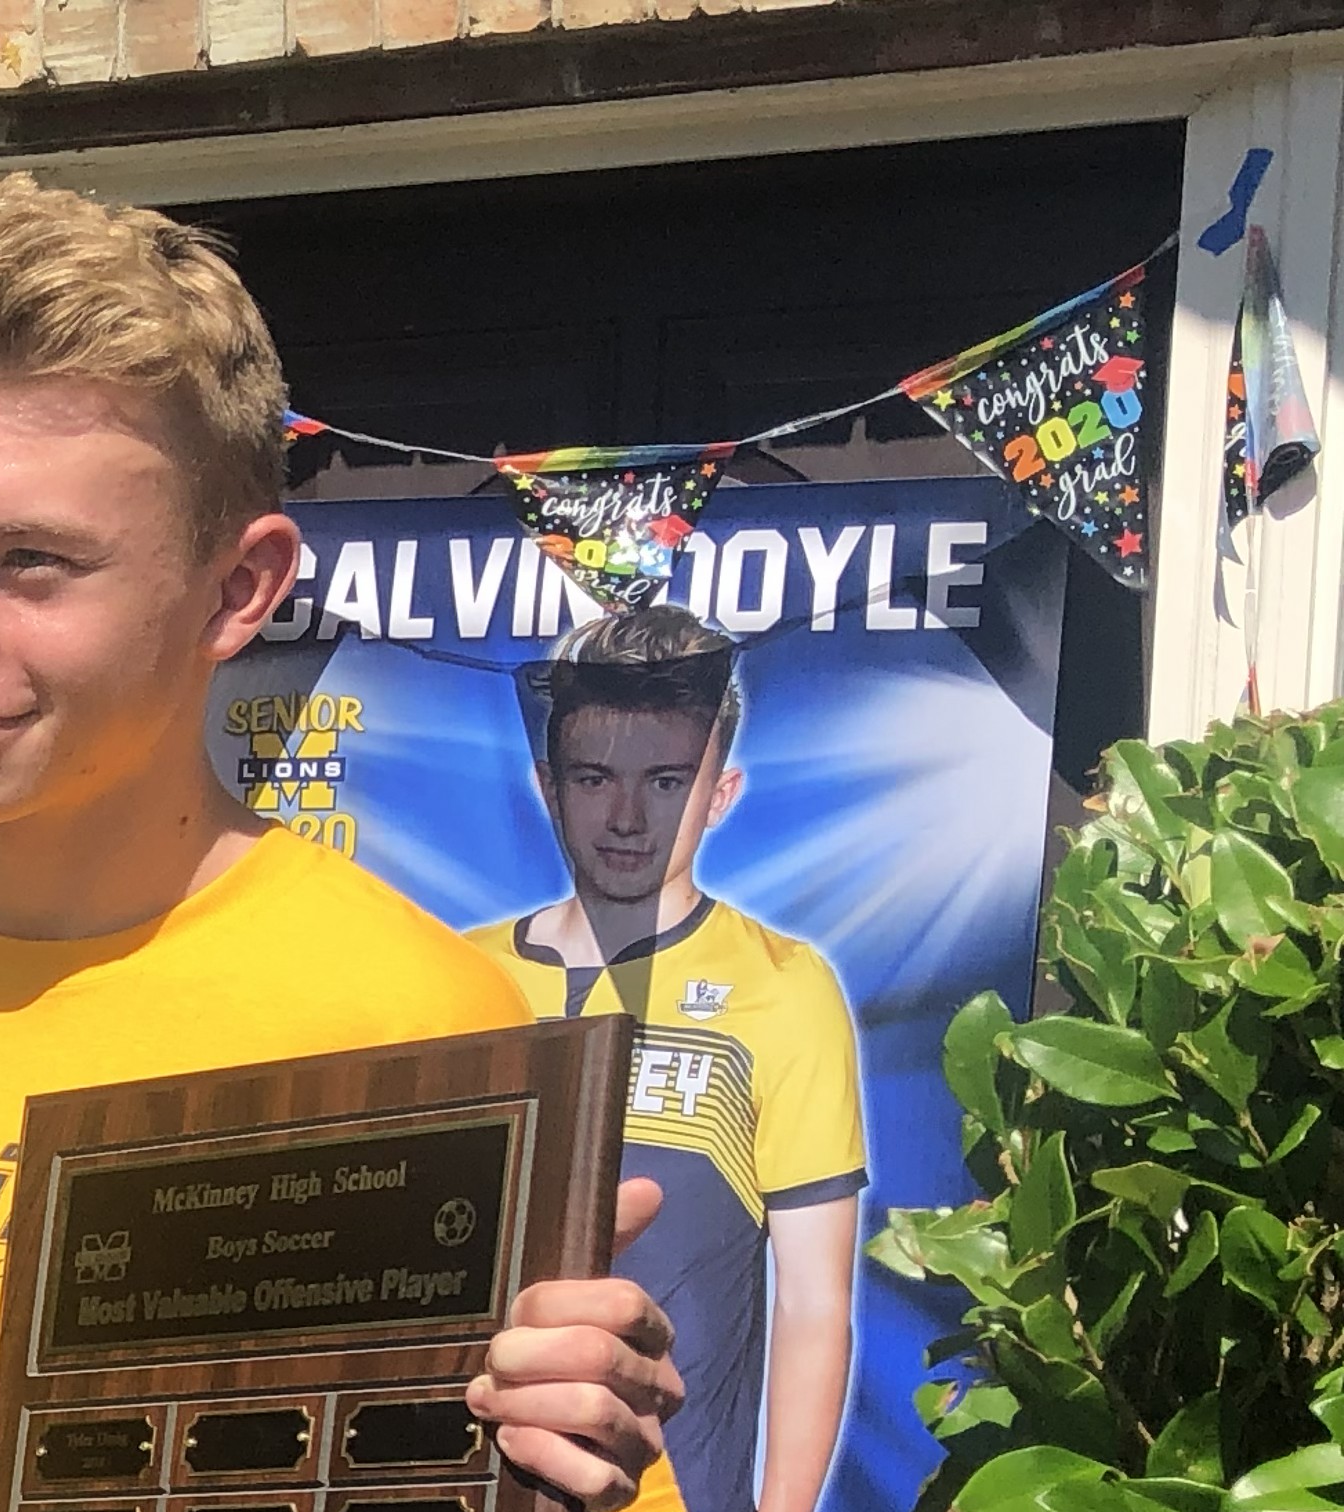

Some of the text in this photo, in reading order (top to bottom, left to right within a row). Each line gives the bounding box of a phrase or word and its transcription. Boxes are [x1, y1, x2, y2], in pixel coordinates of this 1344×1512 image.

[978, 323, 1109, 424] congrats
[1004, 388, 1142, 482] 2020
[541, 472, 678, 537] congrats
[1058, 433, 1136, 520] grad
[225, 690, 365, 734] SENIOR
[243, 761, 341, 779] LIONS
[152, 1160, 408, 1215] McKinney High School
[206, 1226, 336, 1261] Boys Soccer
[77, 1266, 468, 1327] Most Valuable Offensive Player
